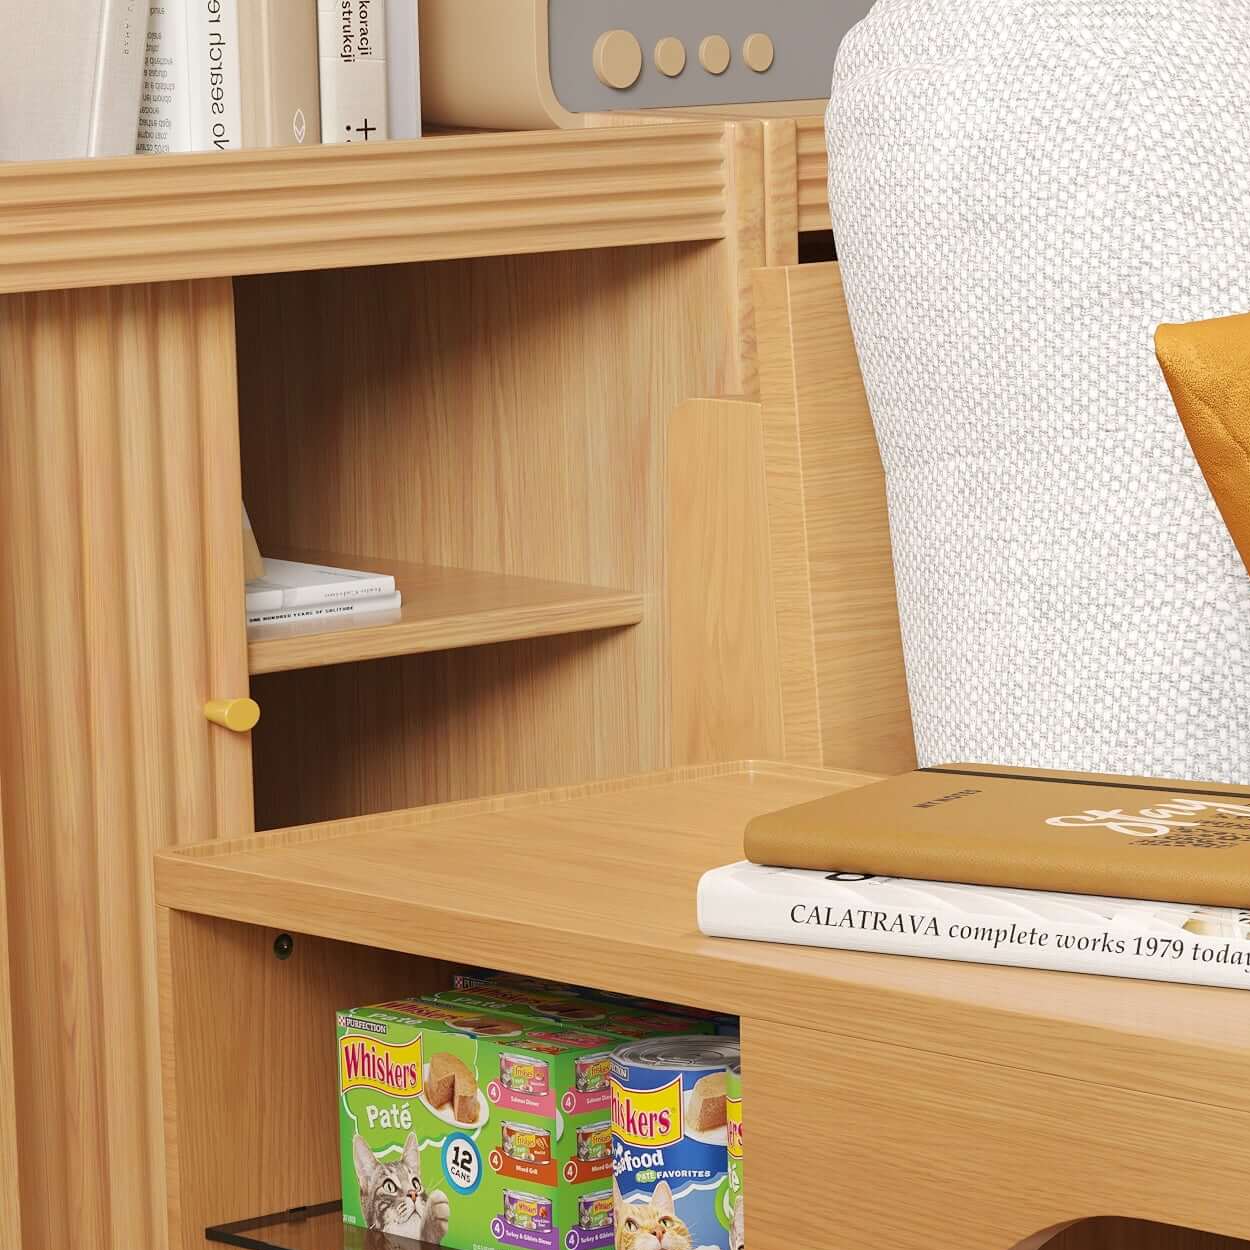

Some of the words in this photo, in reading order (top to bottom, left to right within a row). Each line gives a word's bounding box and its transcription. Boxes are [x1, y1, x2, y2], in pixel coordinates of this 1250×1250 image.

[790, 904, 941, 937] CALATRAVA
[949, 923, 1049, 949] complete
[1056, 933, 1125, 954] works
[1133, 936, 1185, 960] 1979
[347, 1018, 386, 1033] PURFECTION
[344, 1042, 417, 1089] Whiskers
[366, 1102, 412, 1130] Paté
[452, 1146, 473, 1172] 12
[450, 1166, 471, 1184] CANS
[656, 1170, 711, 1179] FAVORITES
